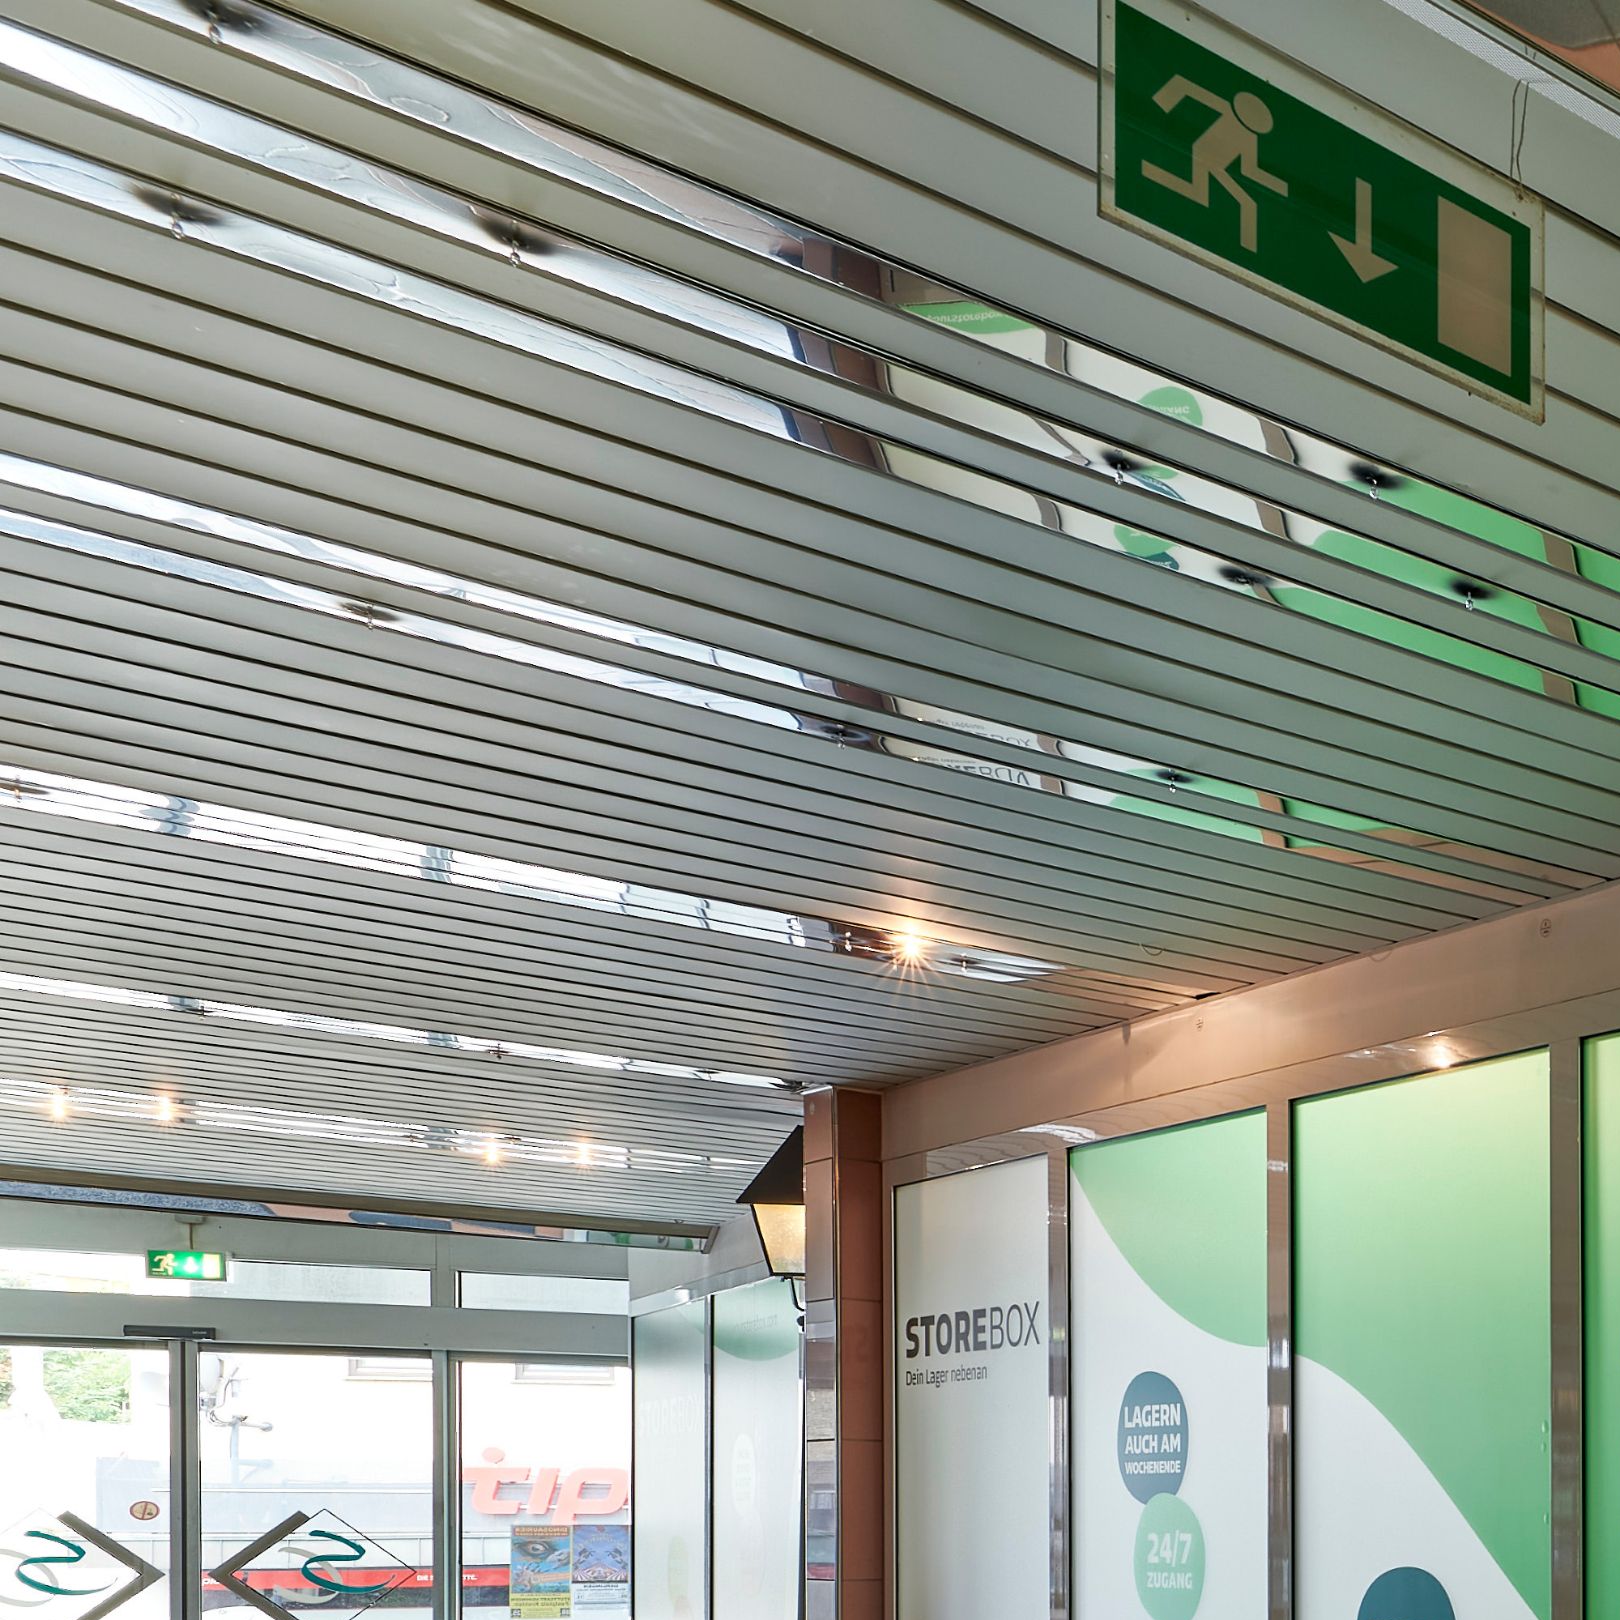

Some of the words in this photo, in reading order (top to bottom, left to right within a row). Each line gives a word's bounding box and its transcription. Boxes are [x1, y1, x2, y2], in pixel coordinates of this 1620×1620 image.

[906, 1302, 1039, 1358] STOREBOX
[906, 1371, 923, 1385] Dein
[926, 1370, 948, 1388] Lager
[951, 1365, 987, 1381] nebenan
[1123, 1402, 1181, 1428] LAGERN
[1125, 1435, 1157, 1454] AUCH
[1161, 1434, 1180, 1452] AM
[1125, 1460, 1182, 1475] WOCHENENDE
[1148, 1530, 1191, 1567] 24/7
[1147, 1572, 1192, 1589] ZUGANG
